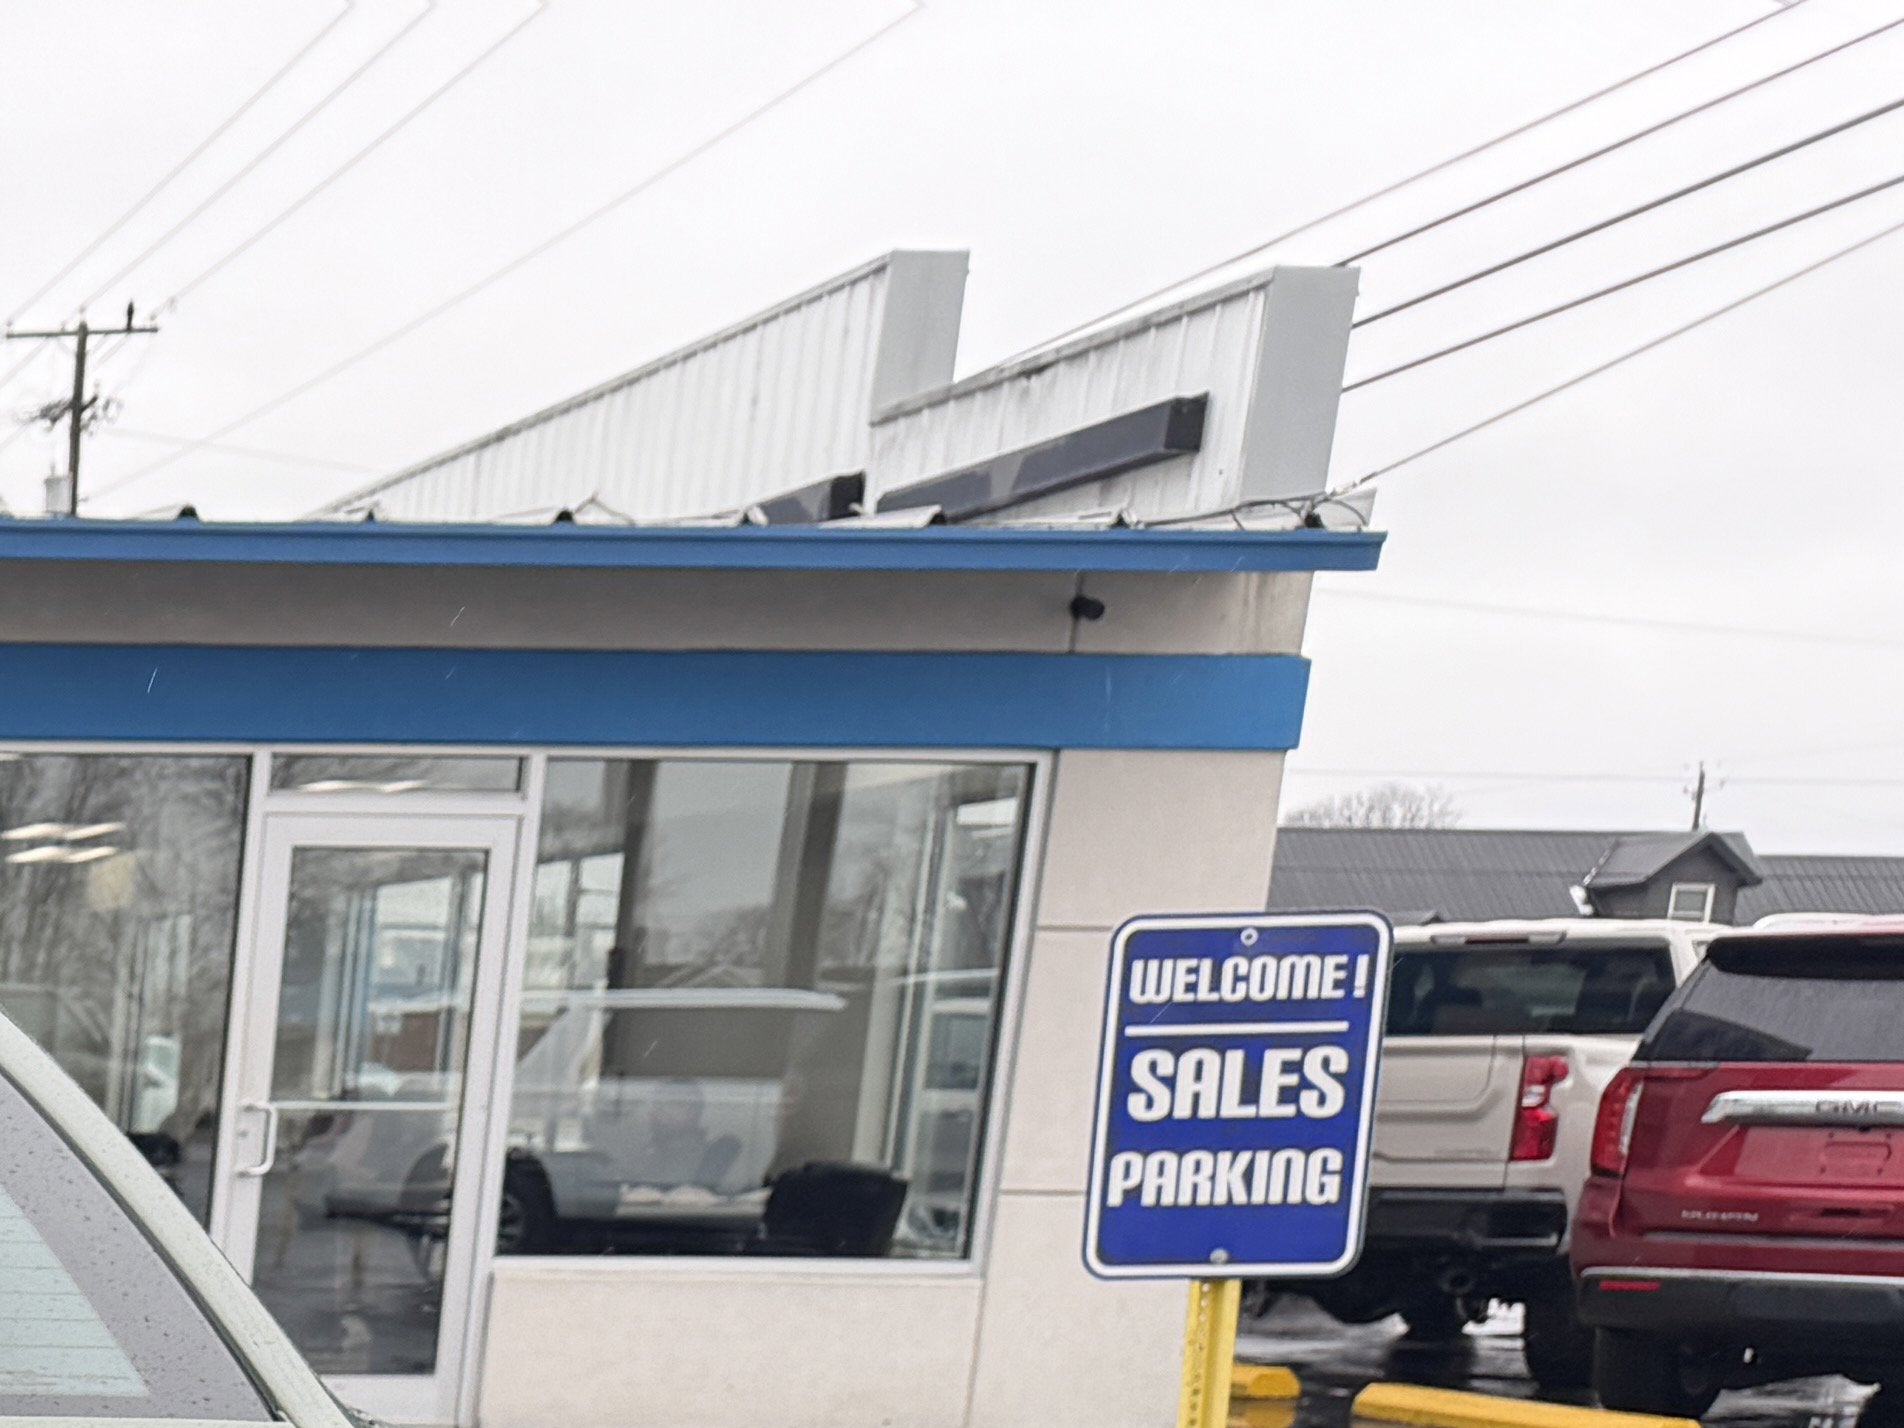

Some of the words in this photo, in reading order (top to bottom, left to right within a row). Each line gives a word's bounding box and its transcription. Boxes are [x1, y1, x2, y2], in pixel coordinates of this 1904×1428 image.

[1129, 953, 1370, 1004] WELCOME!
[1127, 1045, 1350, 1122] SALES
[1106, 1147, 1343, 1208] PARKING
